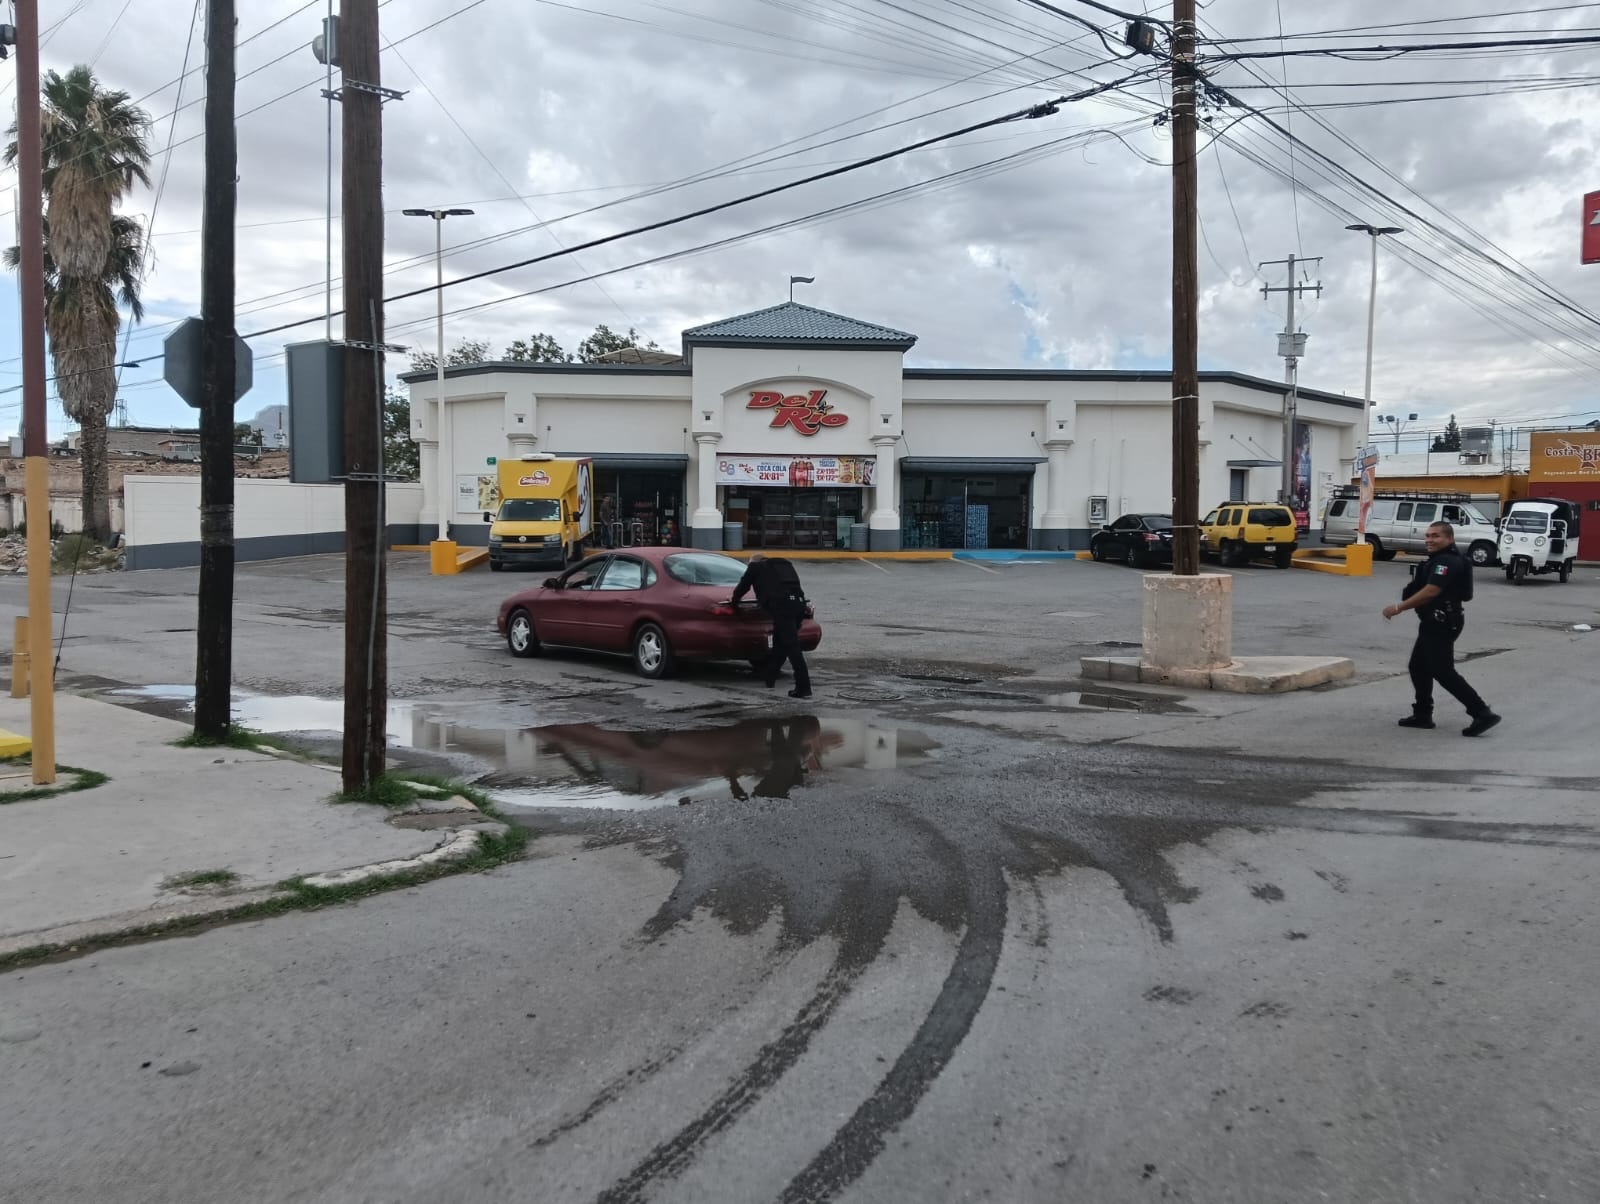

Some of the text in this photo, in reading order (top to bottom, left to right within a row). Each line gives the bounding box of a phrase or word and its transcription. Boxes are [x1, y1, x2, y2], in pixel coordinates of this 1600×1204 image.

[746, 389, 827, 409] Del
[769, 406, 849, 437] Rio
[1545, 447, 1574, 457] Costa
